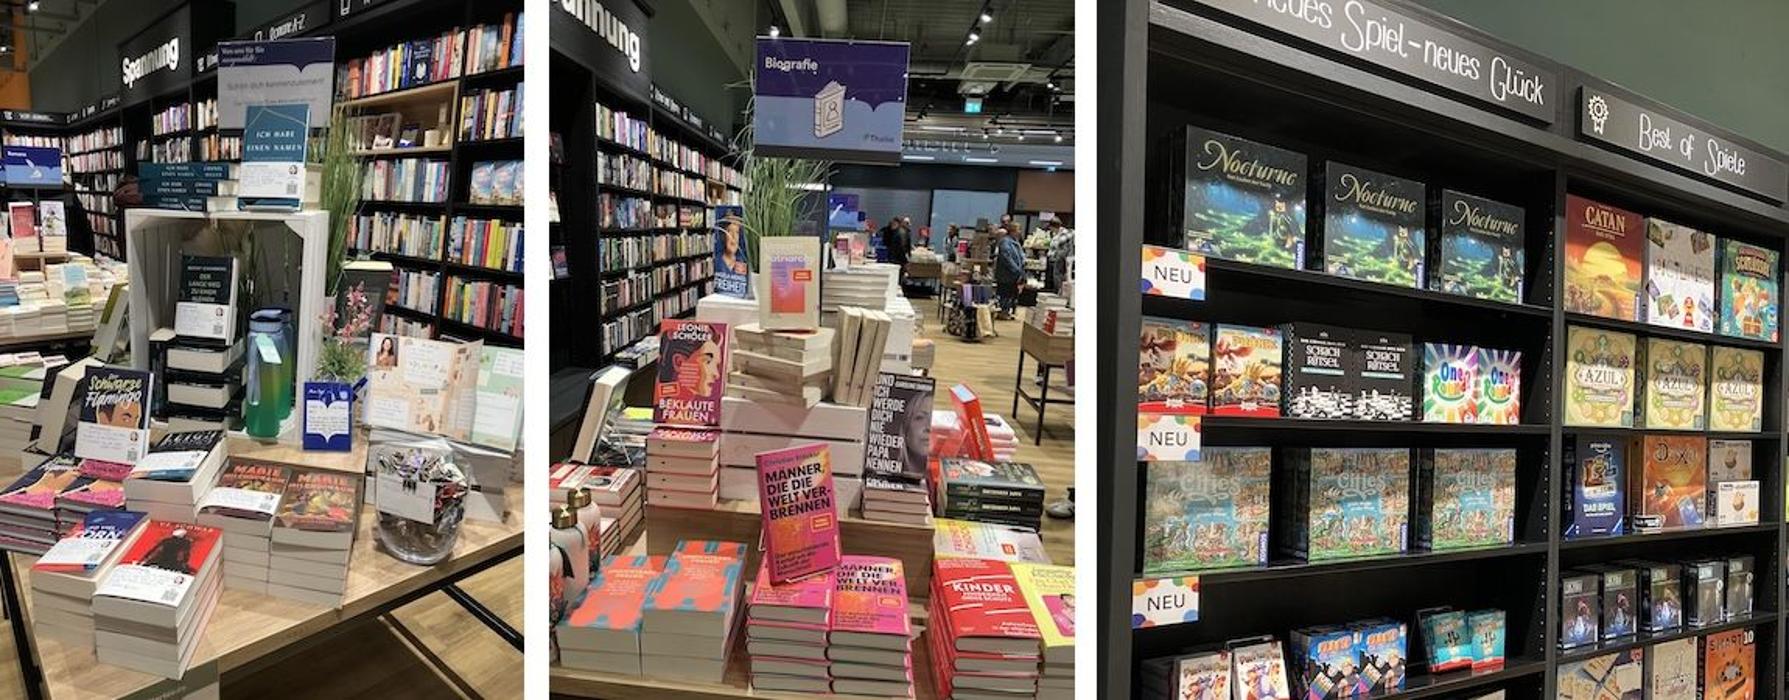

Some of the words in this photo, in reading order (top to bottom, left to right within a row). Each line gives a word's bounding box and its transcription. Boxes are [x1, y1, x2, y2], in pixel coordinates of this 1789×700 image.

[122, 37, 179, 89] Spannung
[764, 56, 819, 72] Biografie
[1490, 55, 1544, 105] Glück
[1638, 112, 1672, 150] Best
[1679, 134, 1695, 161] of
[1704, 138, 1746, 176] Spiele
[1197, 139, 1298, 186] Nocturne
[1334, 173, 1418, 214] Nocturne
[1449, 200, 1519, 236] Nocturne
[1585, 206, 1625, 231] CATAN
[1154, 264, 1192, 284] NEU
[677, 323, 710, 331] LEONIE
[89, 374, 143, 391] Schwarze
[1585, 369, 1619, 385] AZUL
[1663, 377, 1692, 391] AZUL
[1724, 383, 1751, 395] AZUL
[84, 390, 143, 409] Flamingo
[659, 399, 715, 411] BEKLAUTE
[873, 398, 906, 412] WERDE
[662, 410, 709, 421] FRAUEN
[871, 408, 894, 422] DICH
[870, 420, 885, 433] NIE
[869, 433, 905, 448] WIEDER
[1150, 431, 1188, 446] NEU
[867, 445, 889, 459] PAPA
[233, 464, 281, 478] MARIE
[866, 458, 903, 473] NENNEN
[767, 482, 789, 496] DIE
[792, 476, 812, 490] DIE
[1180, 473, 1241, 496] Cities
[1338, 472, 1386, 492] Cities
[1456, 471, 1496, 487] Cities
[768, 492, 800, 508] WELT
[801, 485, 832, 500] VER-
[769, 498, 831, 520] BRENNEN
[1583, 502, 1598, 513] DAS
[836, 571, 858, 579] DIE
[861, 571, 884, 580] DIE
[836, 585, 901, 595] BRENNEN
[953, 582, 1016, 594] KINDER
[1147, 594, 1185, 612] NEU
[1709, 634, 1742, 651] SMART
[1743, 630, 1754, 645] 10
